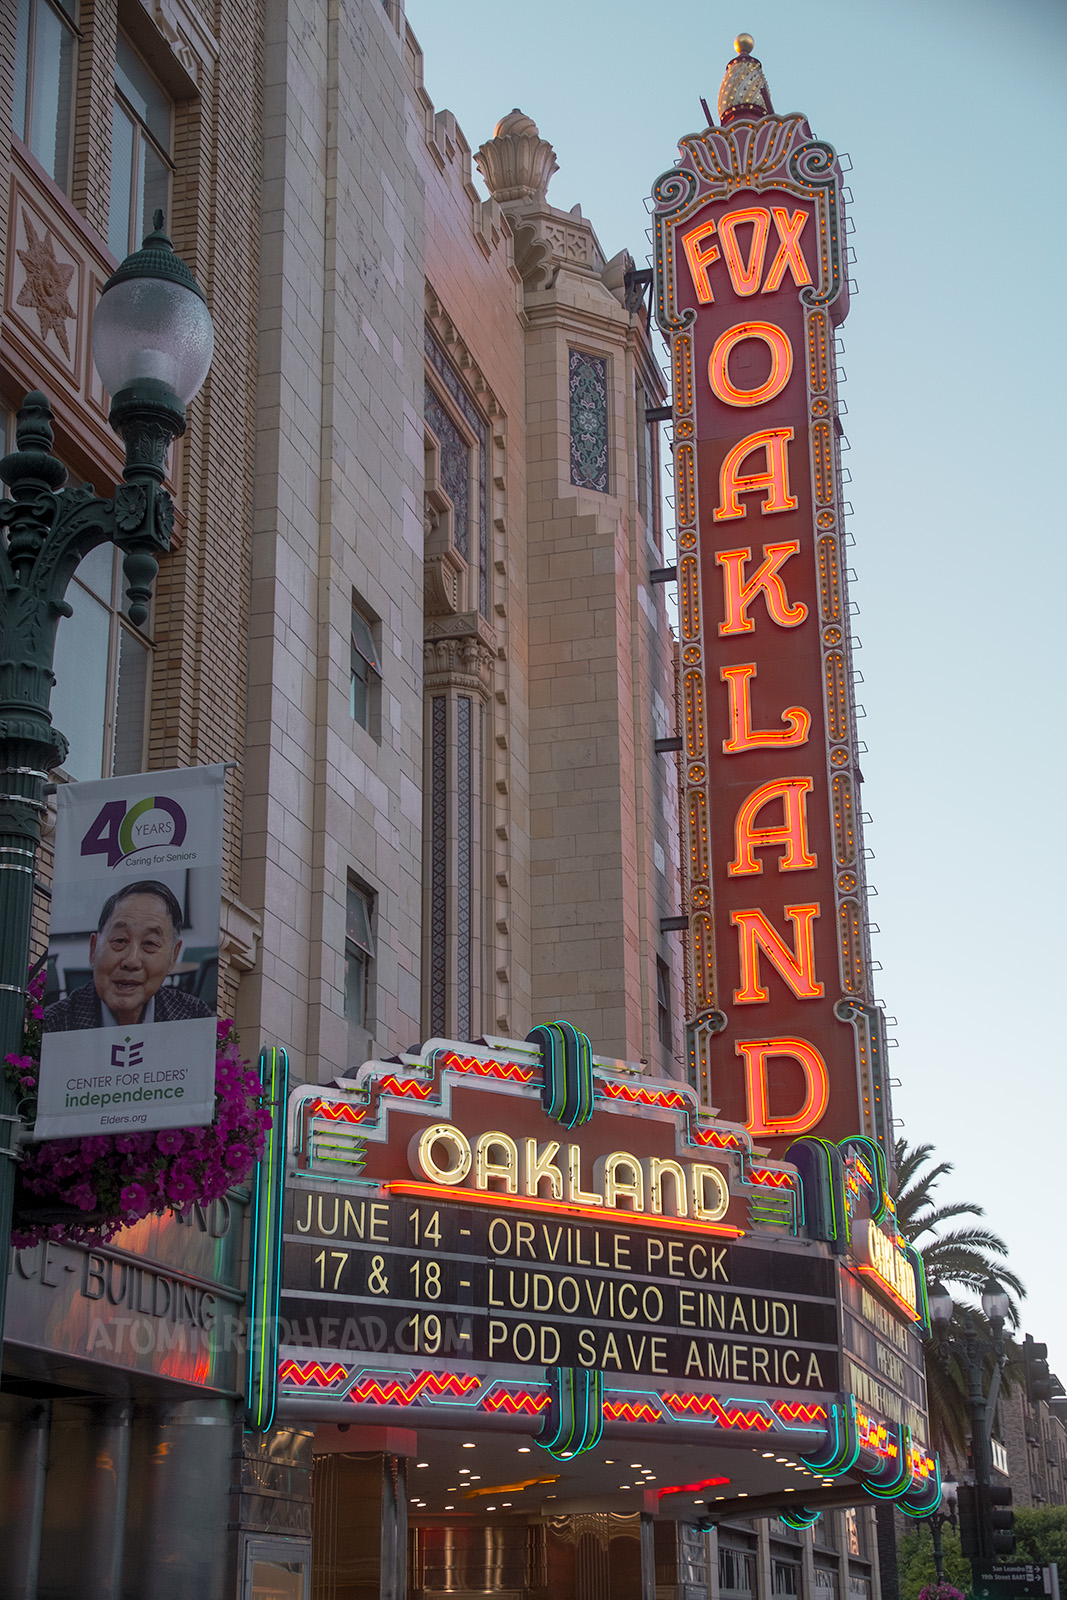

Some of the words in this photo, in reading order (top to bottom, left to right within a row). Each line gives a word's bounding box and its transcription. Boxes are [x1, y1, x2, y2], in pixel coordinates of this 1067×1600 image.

[682, 206, 813, 305] FOX
[708, 321, 829, 1136] OAKLAND
[81, 796, 187, 867] 40
[125, 856, 151, 867] Caring
[153, 853, 165, 863] for
[166, 852, 197, 862] Seniors
[135, 821, 172, 836] YEARS
[65, 1086, 185, 1108] independence
[66, 1076, 112, 1090] CENTER
[115, 1073, 139, 1086] FOR
[100, 1114, 147, 1125] Elders.org
[410, 1123, 730, 1222] OAKLAND
[296, 1194, 390, 1242] JUNE
[408, 1208, 442, 1247] 14
[488, 1218, 632, 1270] ORVILLE
[647, 1238, 729, 1283] PECK
[314, 1250, 349, 1290] 17
[367, 1255, 390, 1295] &
[409, 1260, 442, 1300] 18
[488, 1268, 664, 1323] LUDOVICO
[679, 1290, 798, 1338] EINAUDI
[408, 1313, 442, 1354] 19
[488, 1320, 561, 1364] POD
[577, 1328, 669, 1375] SAVE
[684, 1340, 824, 1389] AMERICA
